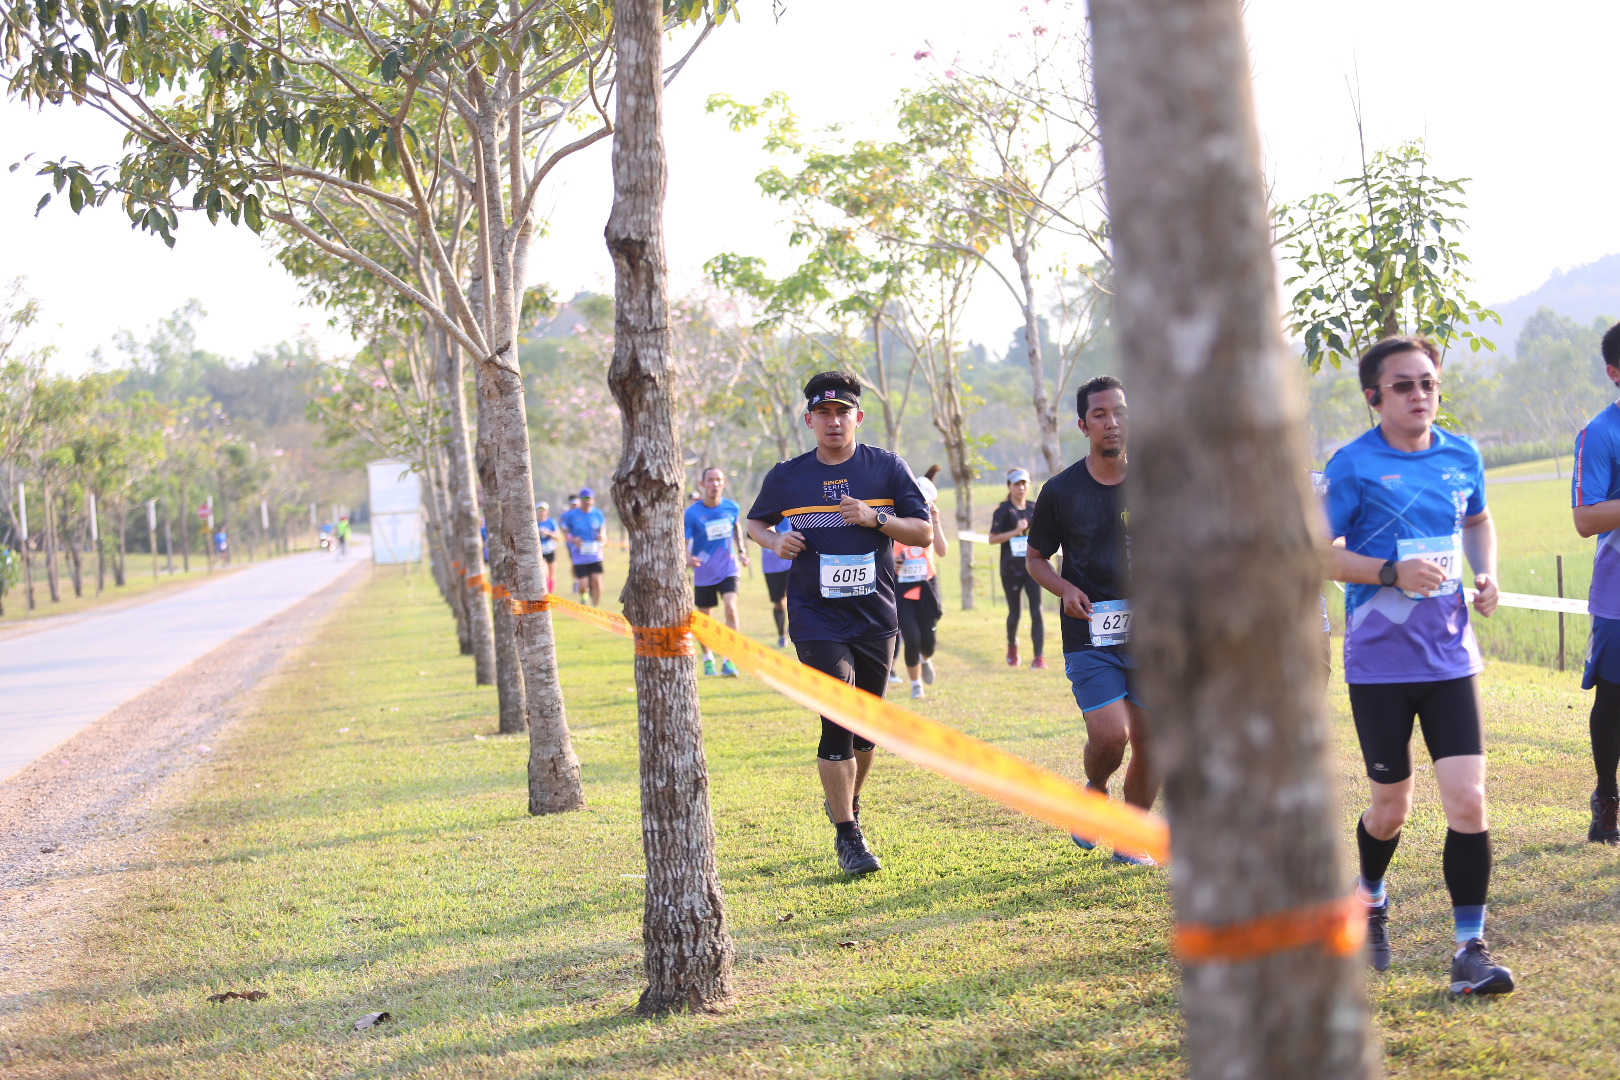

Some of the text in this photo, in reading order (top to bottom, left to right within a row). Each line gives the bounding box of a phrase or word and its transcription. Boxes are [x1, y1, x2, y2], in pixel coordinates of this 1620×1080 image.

[823, 478, 849, 486] SINGHA
[823, 482, 850, 491] SERIES
[903, 565, 923, 575] 6027
[1426, 555, 1454, 575] 91
[832, 567, 867, 583] 6015
[1102, 613, 1131, 631] 627
